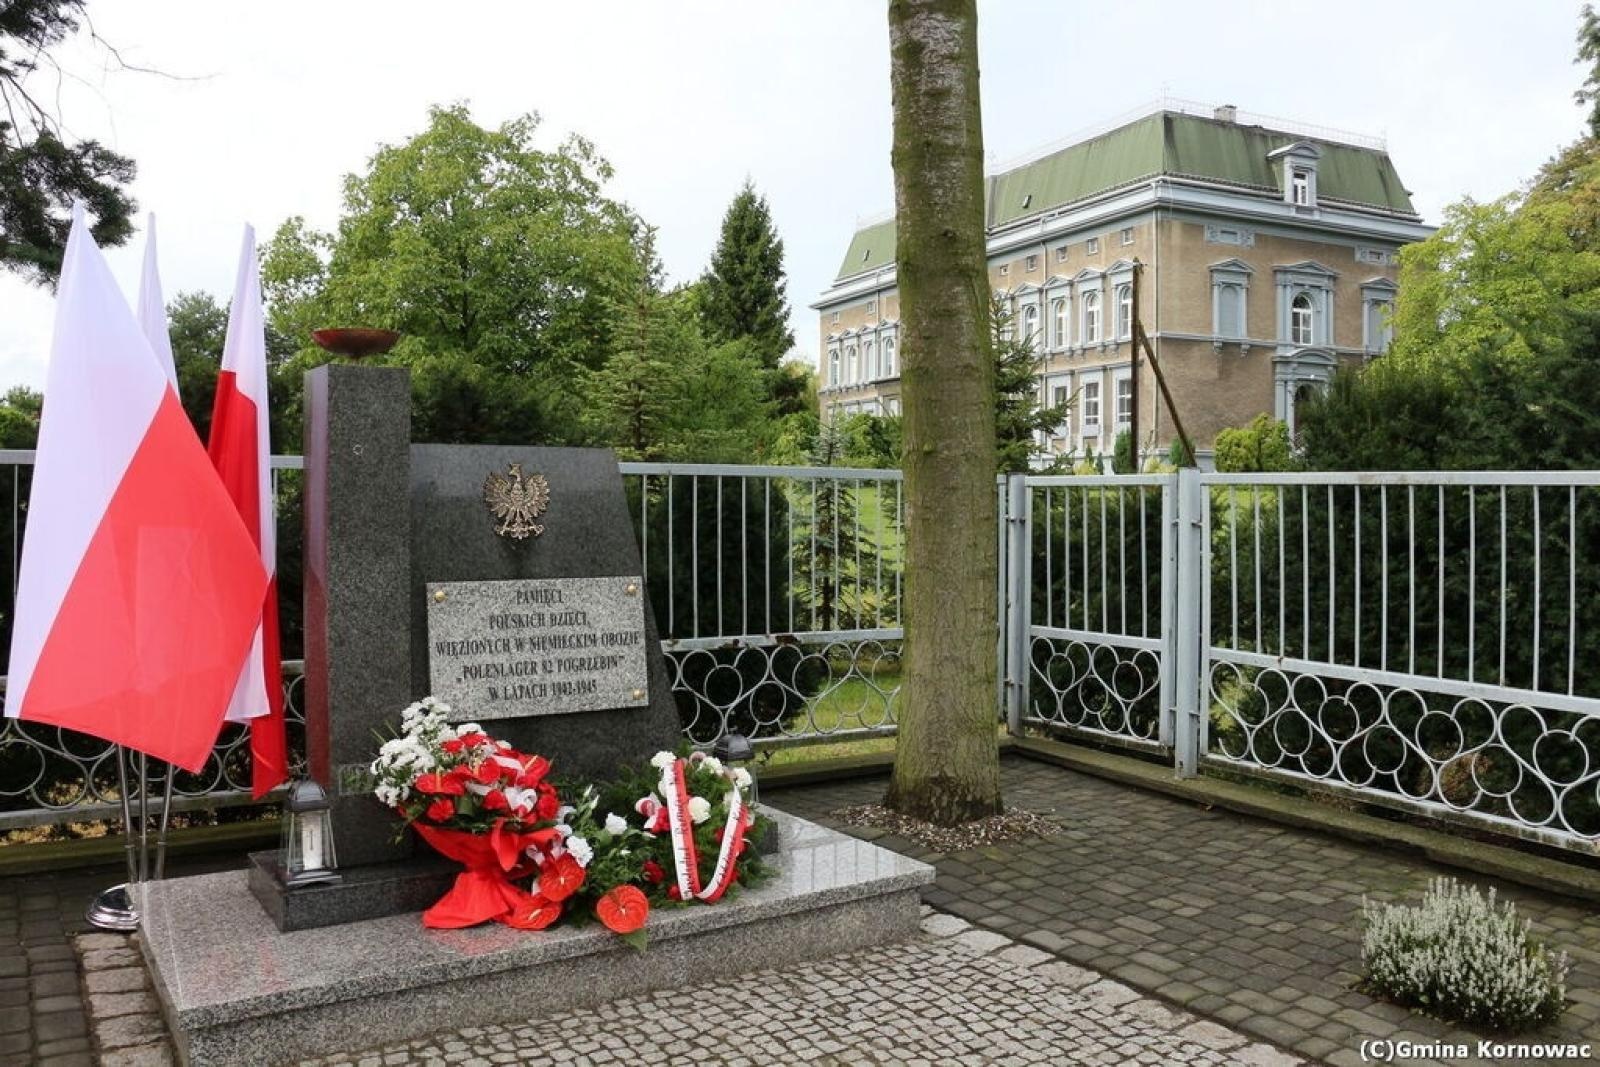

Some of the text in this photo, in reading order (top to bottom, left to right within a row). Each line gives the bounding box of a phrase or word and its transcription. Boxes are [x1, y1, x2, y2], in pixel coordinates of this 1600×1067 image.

[489, 612, 545, 629] POLSKICH
[512, 638, 525, 652] W
[488, 687, 499, 700] W
[504, 683, 547, 700] LATACH
